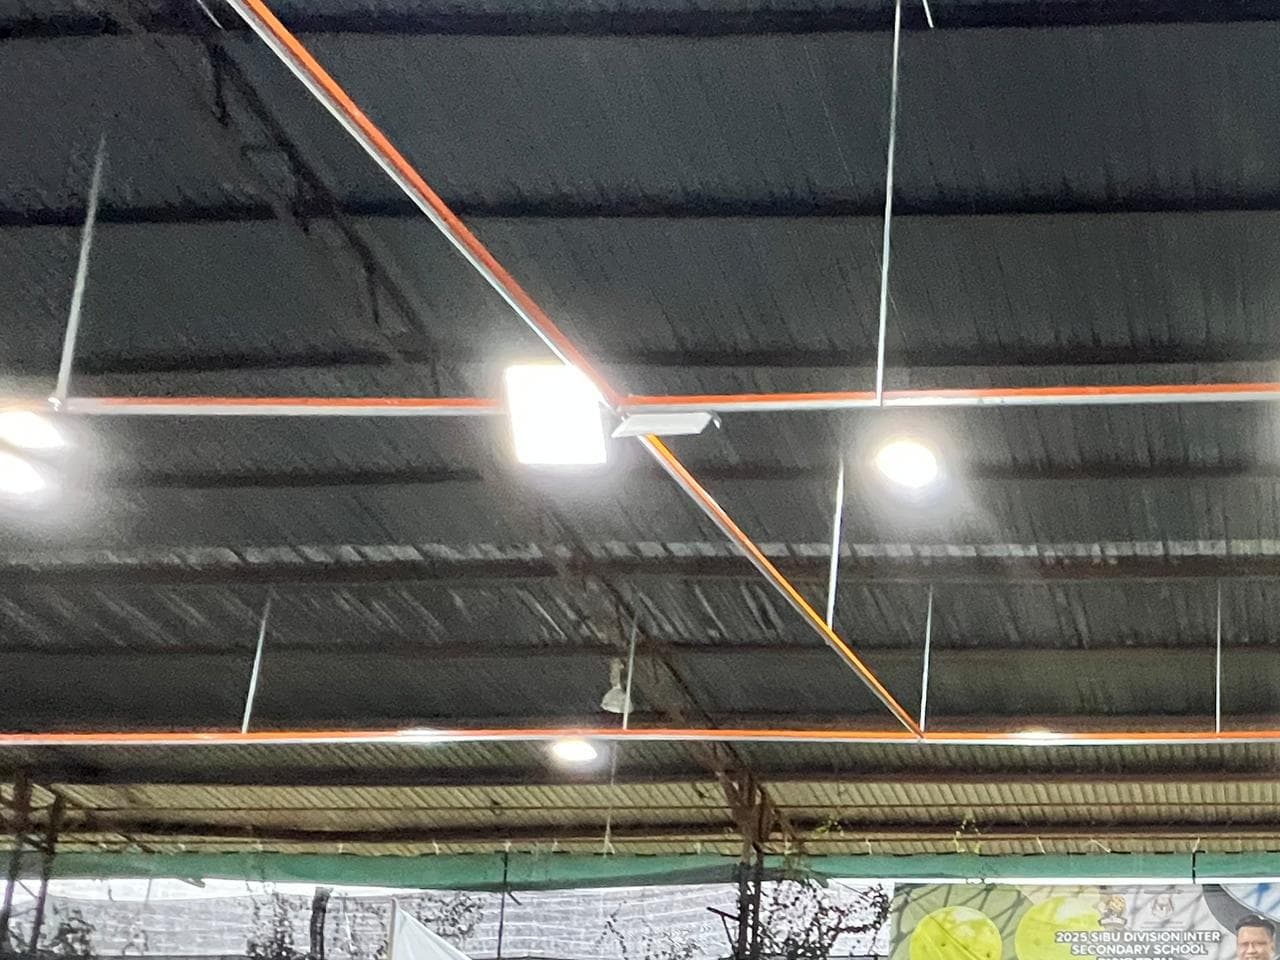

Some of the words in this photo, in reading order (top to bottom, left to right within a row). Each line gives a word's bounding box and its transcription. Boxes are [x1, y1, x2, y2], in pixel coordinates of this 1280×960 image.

[1056, 931, 1088, 943] 2025
[1091, 931, 1121, 942] SIBU
[1124, 931, 1180, 942] DIVISION
[1183, 930, 1221, 942] INTER
[1071, 944, 1150, 955] SECONDARY
[1152, 943, 1208, 955] SCHOOL
